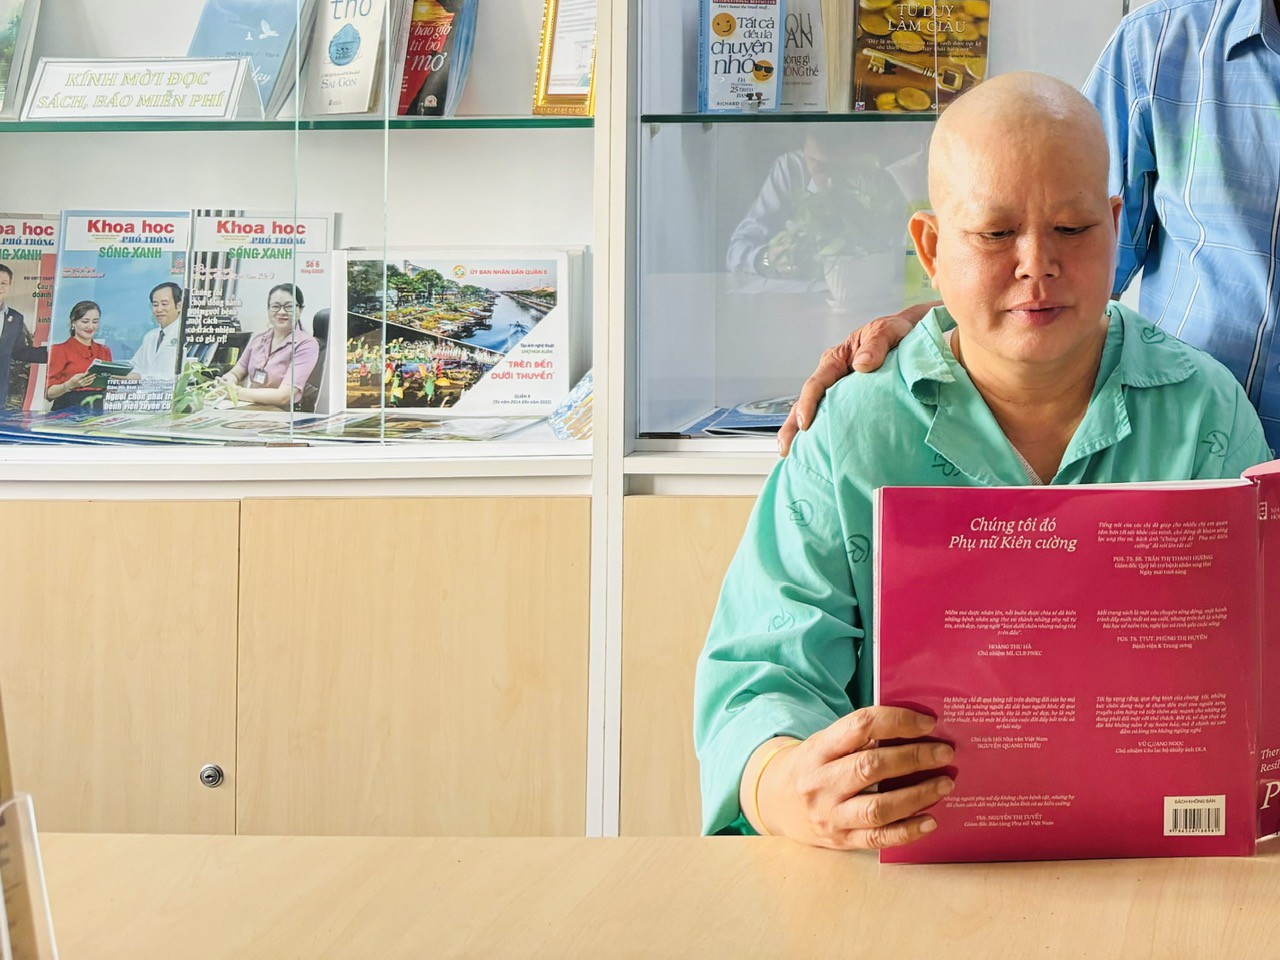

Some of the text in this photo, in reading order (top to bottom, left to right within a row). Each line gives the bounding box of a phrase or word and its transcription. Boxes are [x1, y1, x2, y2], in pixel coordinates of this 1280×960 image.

[897, 2, 920, 17] TƯ
[888, 16, 922, 32] LÀM
[711, 39, 773, 57] chuyện
[714, 54, 756, 75] nhỏ
[64, 68, 211, 90] KÍNH MỜI ĐỌC
[92, 91, 134, 108] BÁO
[135, 89, 185, 108] MIỄN
[188, 90, 227, 108] PHÍ
[22, 221, 55, 237] học
[87, 219, 175, 235] Khoa học
[217, 220, 306, 235] Khoa học
[11, 248, 42, 261] XANH
[99, 245, 162, 259] SỐNG XANH
[228, 245, 292, 260] SỐNG XANH
[970, 516, 1057, 535] Chúng tôi đó
[949, 535, 1078, 552] Phụ nữ Kiên cường
